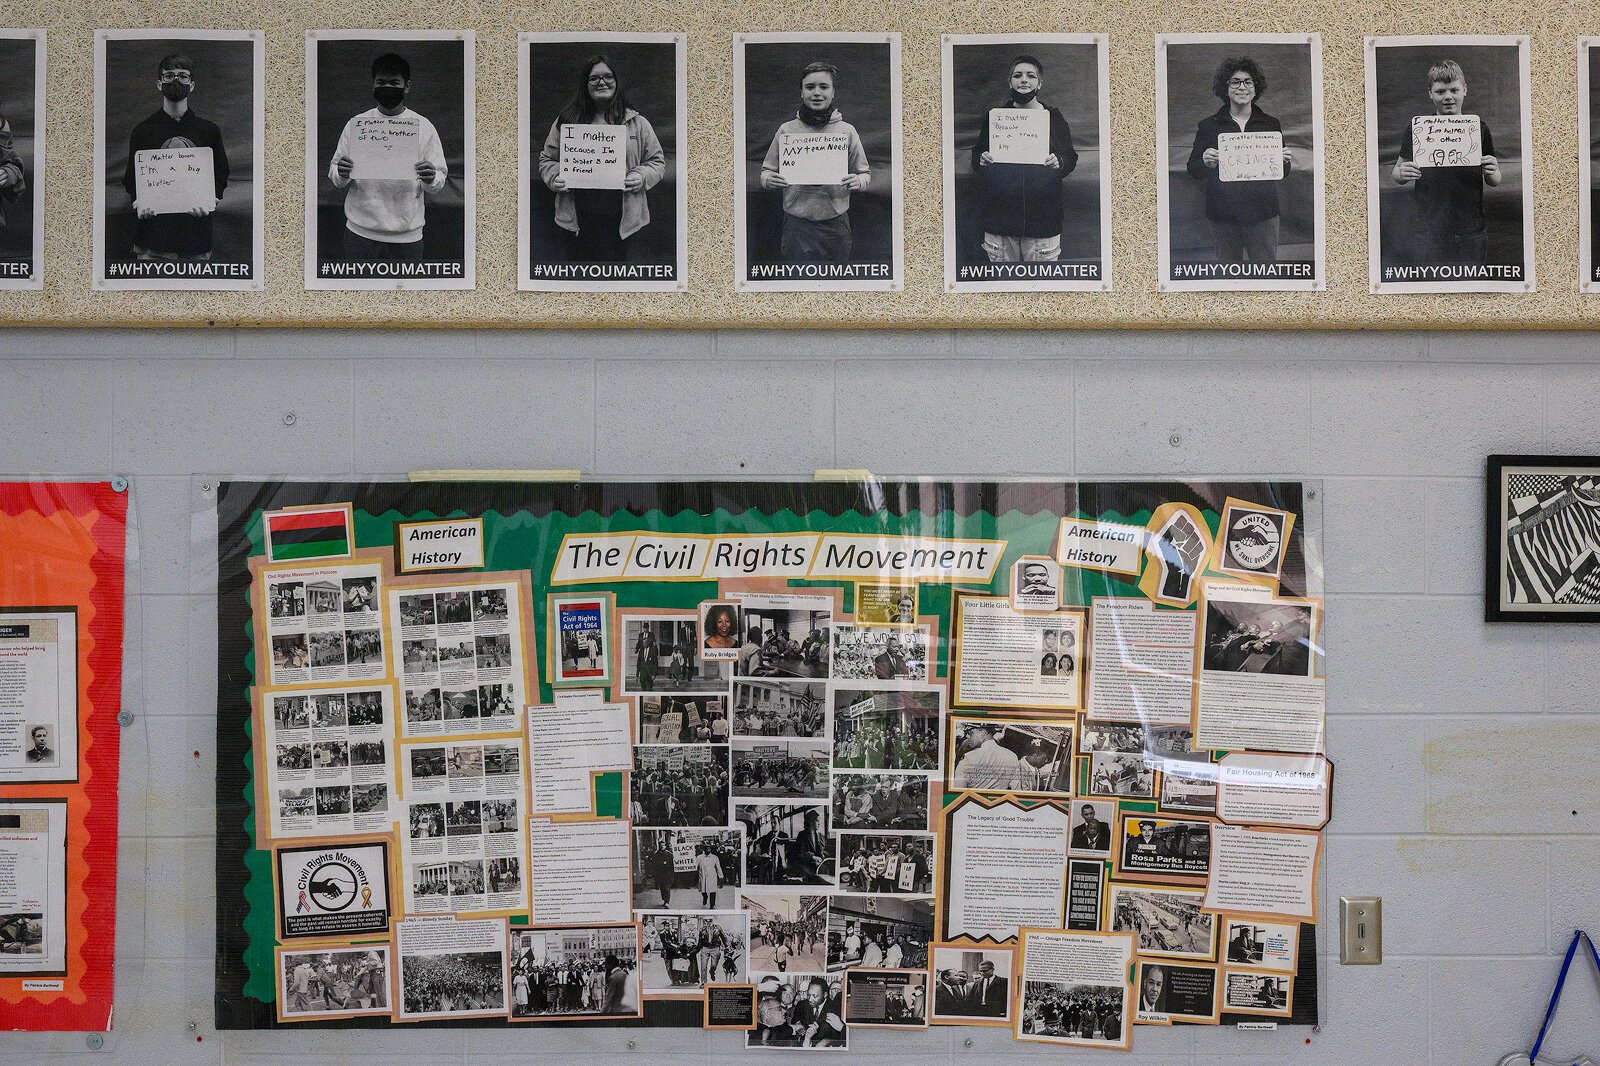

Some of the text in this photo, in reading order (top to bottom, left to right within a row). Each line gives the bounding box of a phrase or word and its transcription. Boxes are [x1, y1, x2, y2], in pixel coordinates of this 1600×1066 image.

[1414, 117, 1420, 125] I
[565, 127, 616, 142] I matter
[784, 135, 790, 145] I
[564, 144, 596, 154] because
[138, 154, 143, 162] I
[1228, 154, 1275, 166] CRINGE
[188, 165, 200, 174] big
[110, 263, 248, 275] #WHYYOUMATTER
[322, 263, 460, 275] #WHYYOUMATTER
[534, 265, 673, 277] #WHYYOUMATTER
[751, 264, 889, 276] #WHYYOUMATTER
[960, 265, 1098, 277] #WHYYOUMATTER
[1175, 264, 1311, 276] #WHYYOUMATTER
[1385, 266, 1521, 277] #WHYYOUMATTER
[1242, 516, 1270, 527] UNITED
[409, 526, 477, 541] American
[1068, 525, 1135, 543] American
[411, 551, 462, 565] History
[569, 540, 988, 573] The Civil Rights Movement
[1067, 549, 1117, 566] History
[1235, 543, 1275, 563] WE SHALL OVERCOME
[578, 615, 597, 623] Rights
[854, 633, 917, 643] WE GO
[1243, 769, 1273, 778] Housing
[1156, 855, 1183, 864] Parks
[298, 852, 369, 890] Civil Rights Movement
